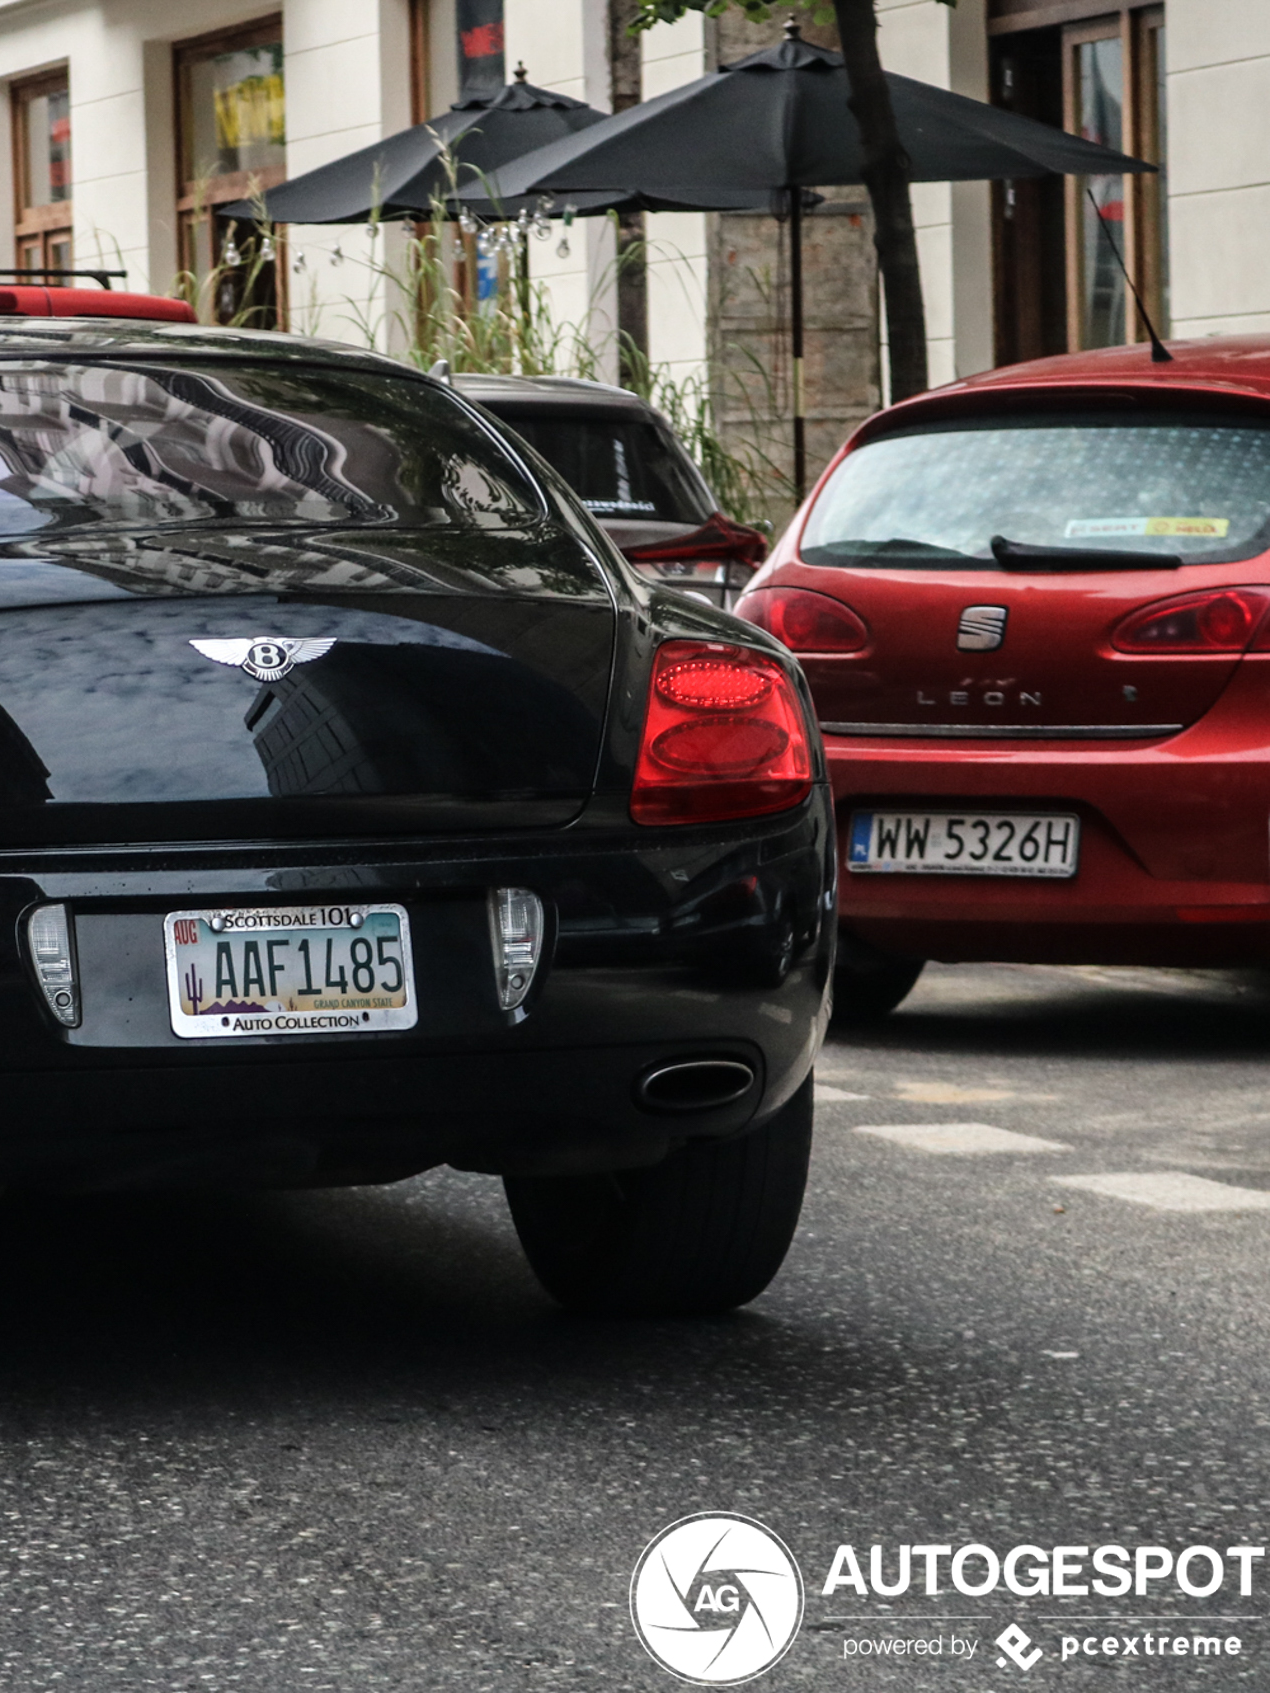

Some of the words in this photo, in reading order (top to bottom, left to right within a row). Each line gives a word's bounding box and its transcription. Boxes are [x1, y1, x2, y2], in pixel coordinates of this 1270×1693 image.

[877, 818, 930, 859] WW
[944, 819, 1070, 863] 5326H
[321, 908, 352, 926] 101
[174, 920, 199, 945] AUG
[215, 936, 403, 998] AAF1485
[313, 1000, 339, 1010] GRAND
[341, 999, 372, 1009] CANYON
[373, 998, 393, 1008] STATE
